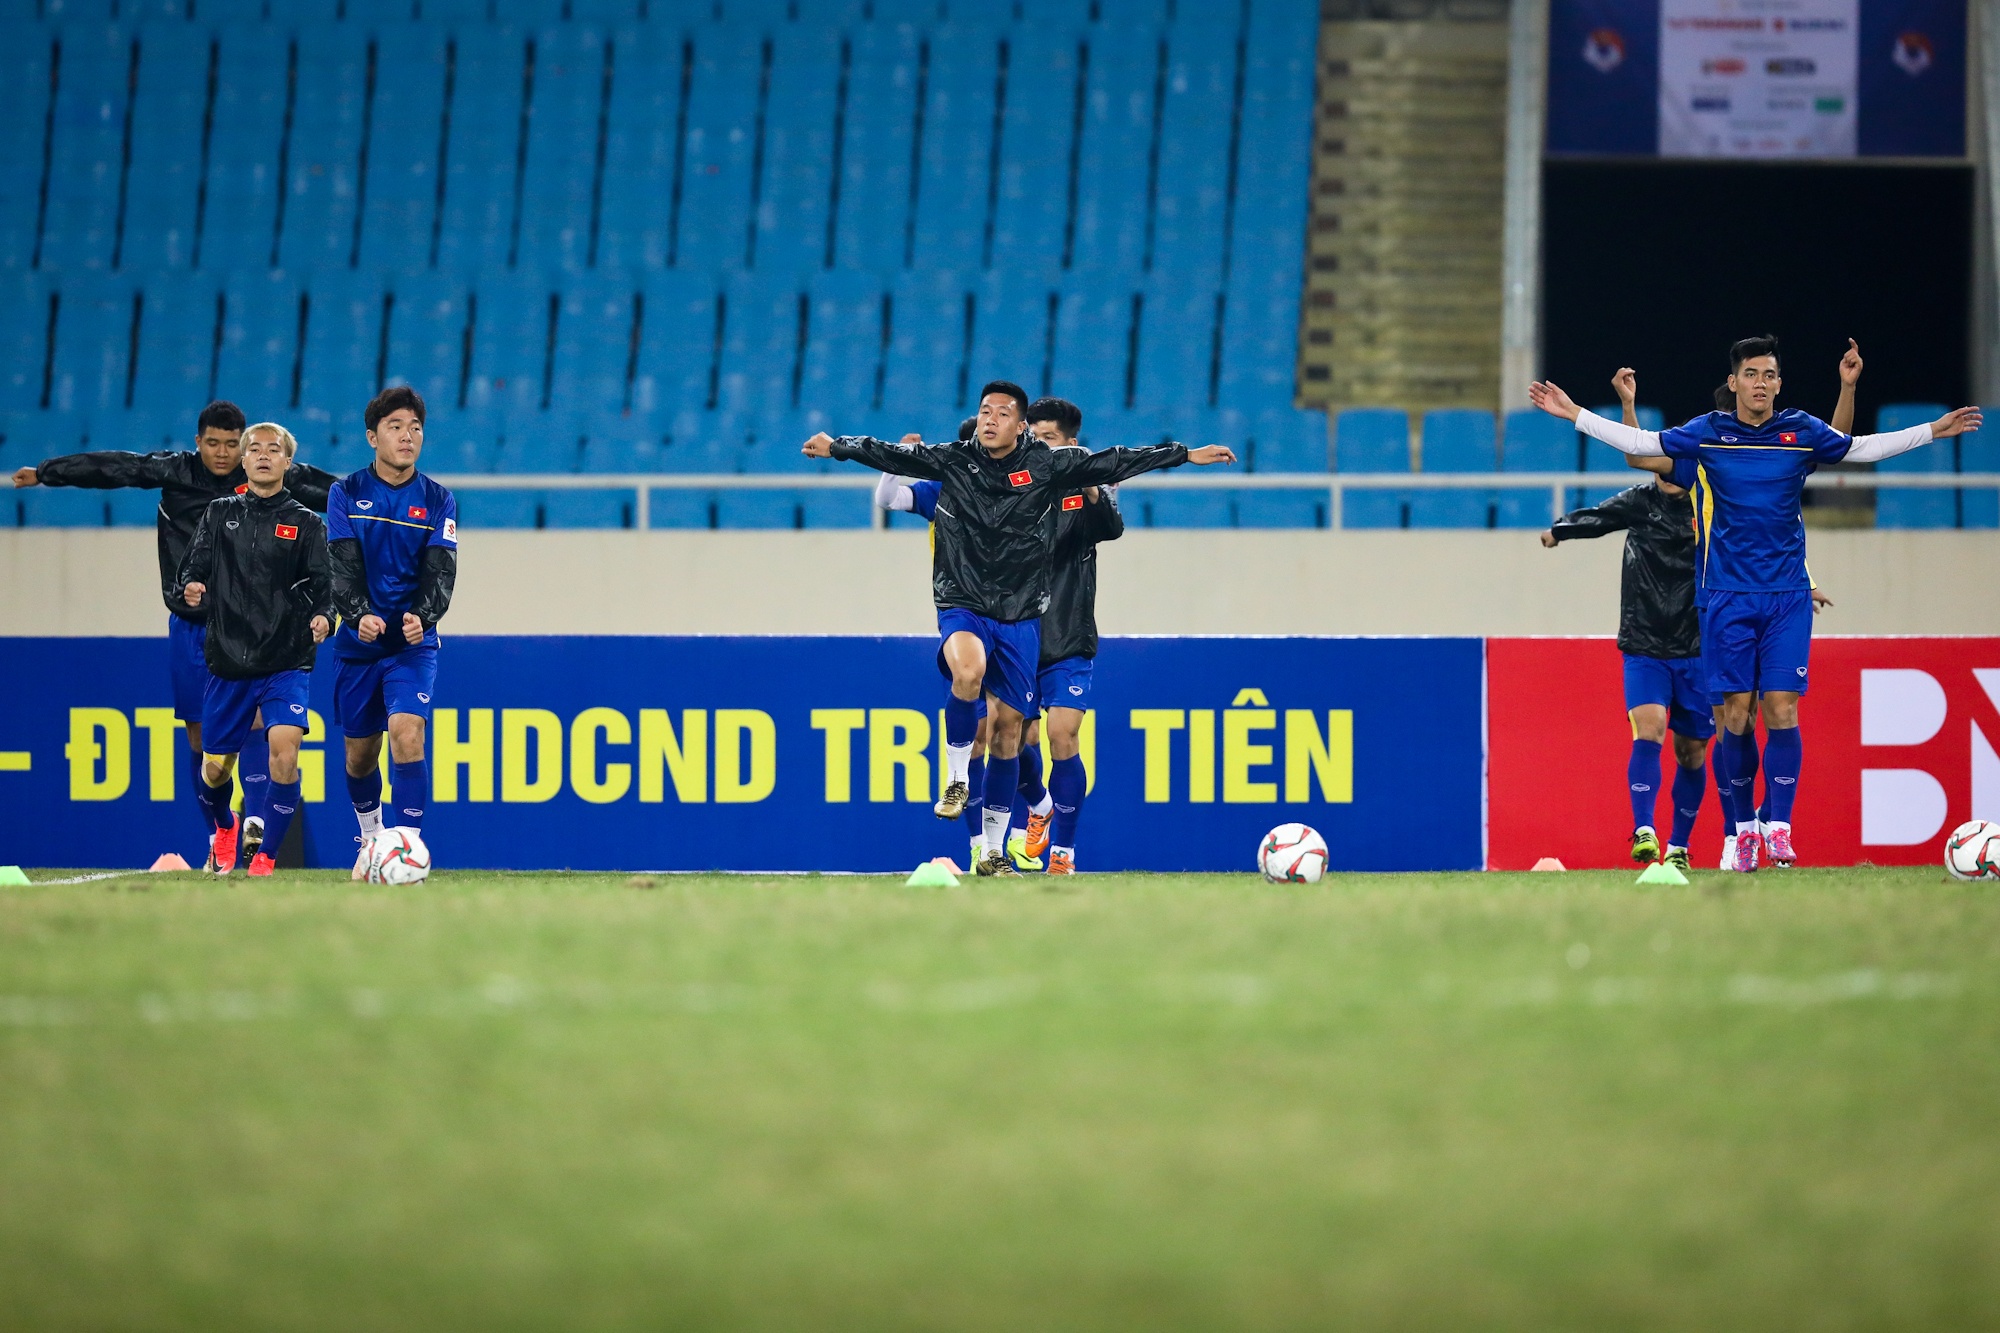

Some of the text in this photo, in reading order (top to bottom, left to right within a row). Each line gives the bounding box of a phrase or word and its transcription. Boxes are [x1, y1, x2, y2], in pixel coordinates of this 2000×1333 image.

[66, 708, 325, 811] ĐTG
[811, 708, 1096, 803] TRU
[1130, 688, 1353, 803] TIÊN
